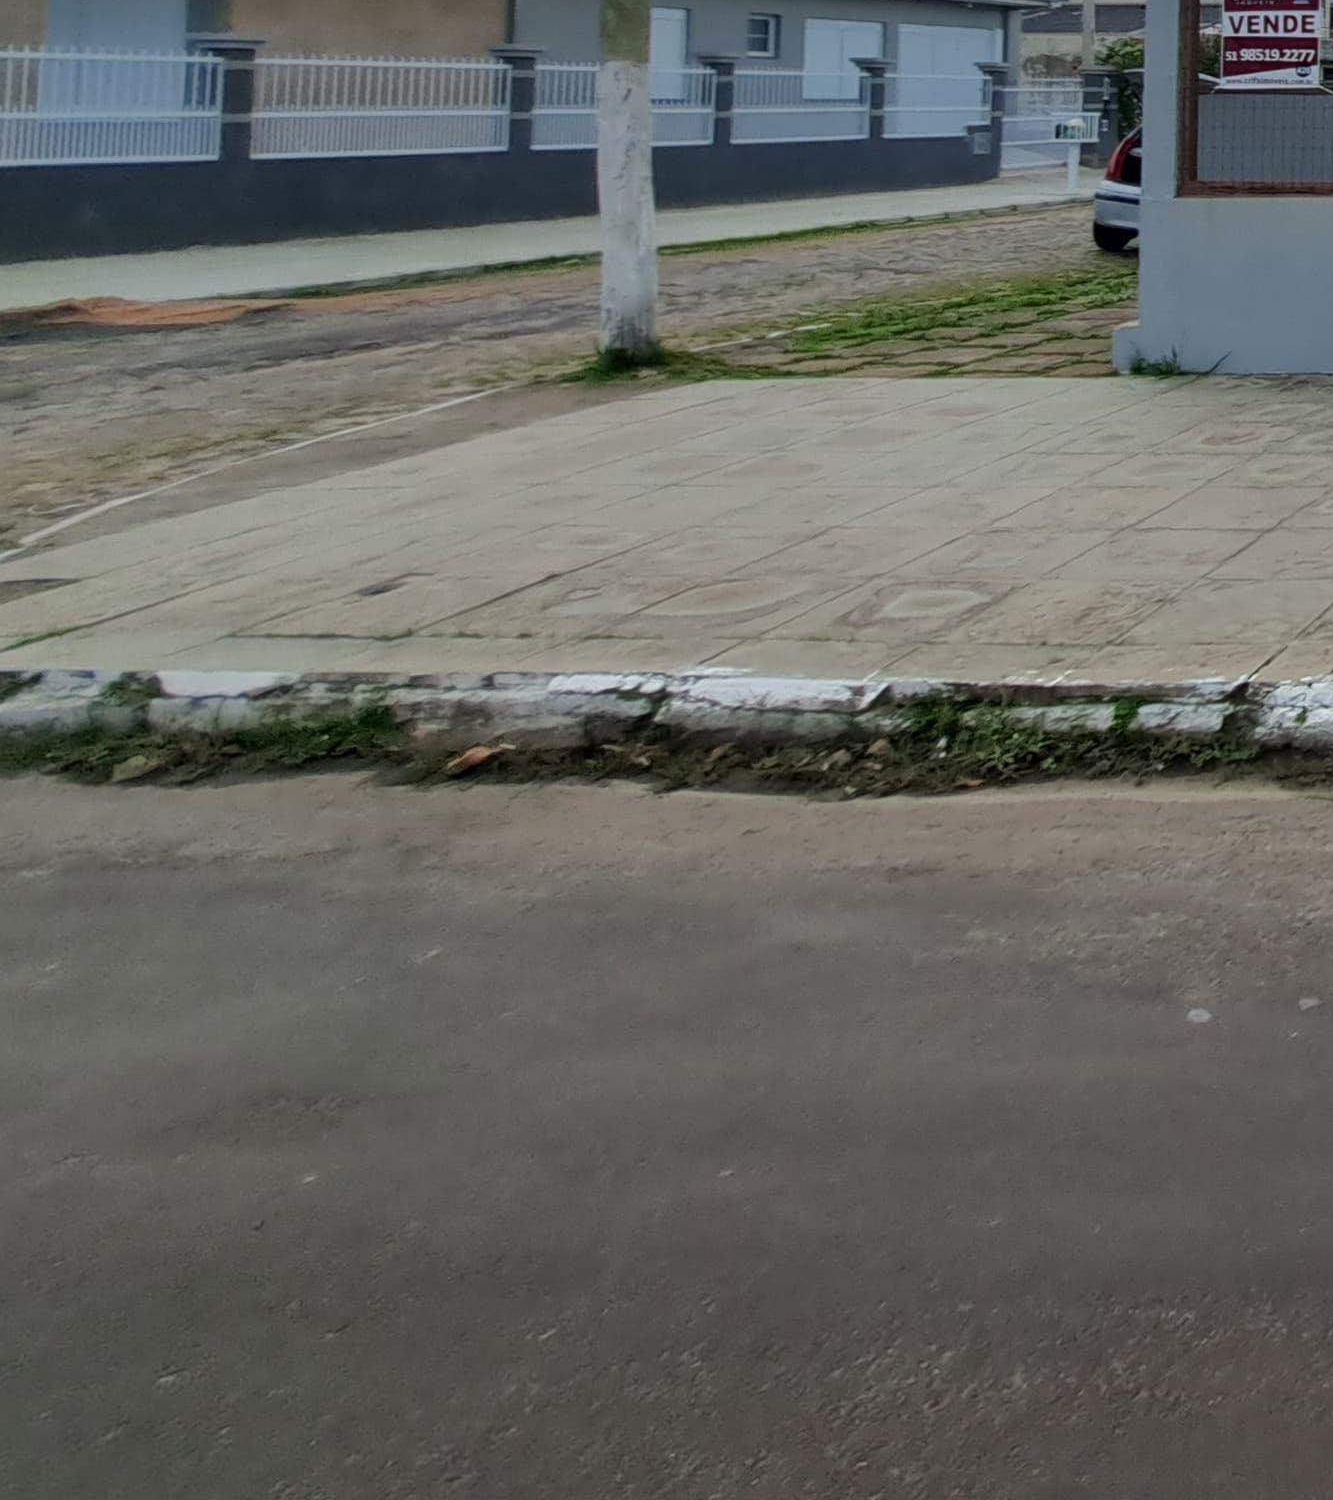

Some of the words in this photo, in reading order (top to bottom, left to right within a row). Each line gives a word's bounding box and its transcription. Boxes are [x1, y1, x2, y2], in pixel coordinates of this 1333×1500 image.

[1229, 15, 1315, 34] VENDE
[1225, 51, 1238, 61] 51
[1239, 48, 1316, 62] 98519.2277
